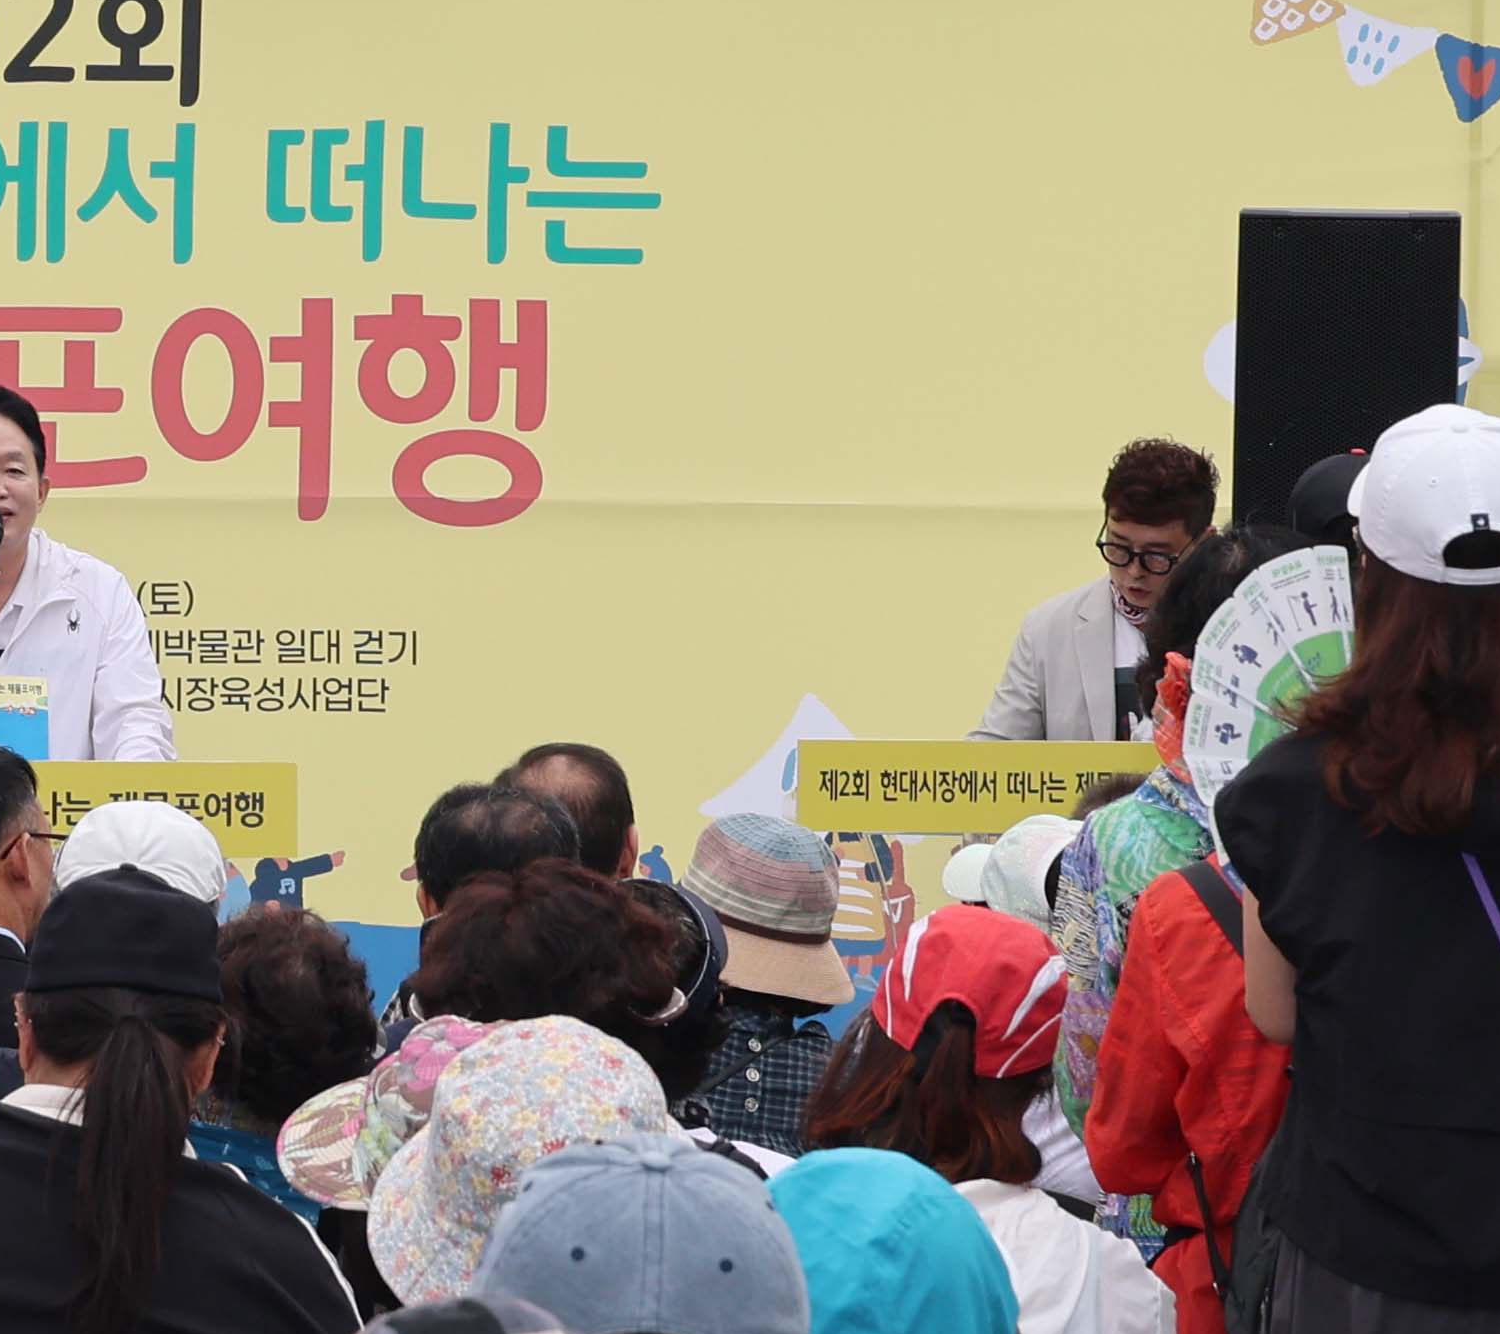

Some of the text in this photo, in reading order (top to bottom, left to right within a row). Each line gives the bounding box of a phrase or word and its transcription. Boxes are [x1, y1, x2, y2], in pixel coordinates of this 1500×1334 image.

[266, 117, 663, 266] 떠나는
[136, 580, 195, 617] (토)
[275, 628, 342, 666] 일대
[352, 629, 418, 666] 걷기
[818, 768, 871, 802] 제2회
[879, 769, 999, 804] 현대시장에서
[1006, 770, 1068, 804] 떠나는
